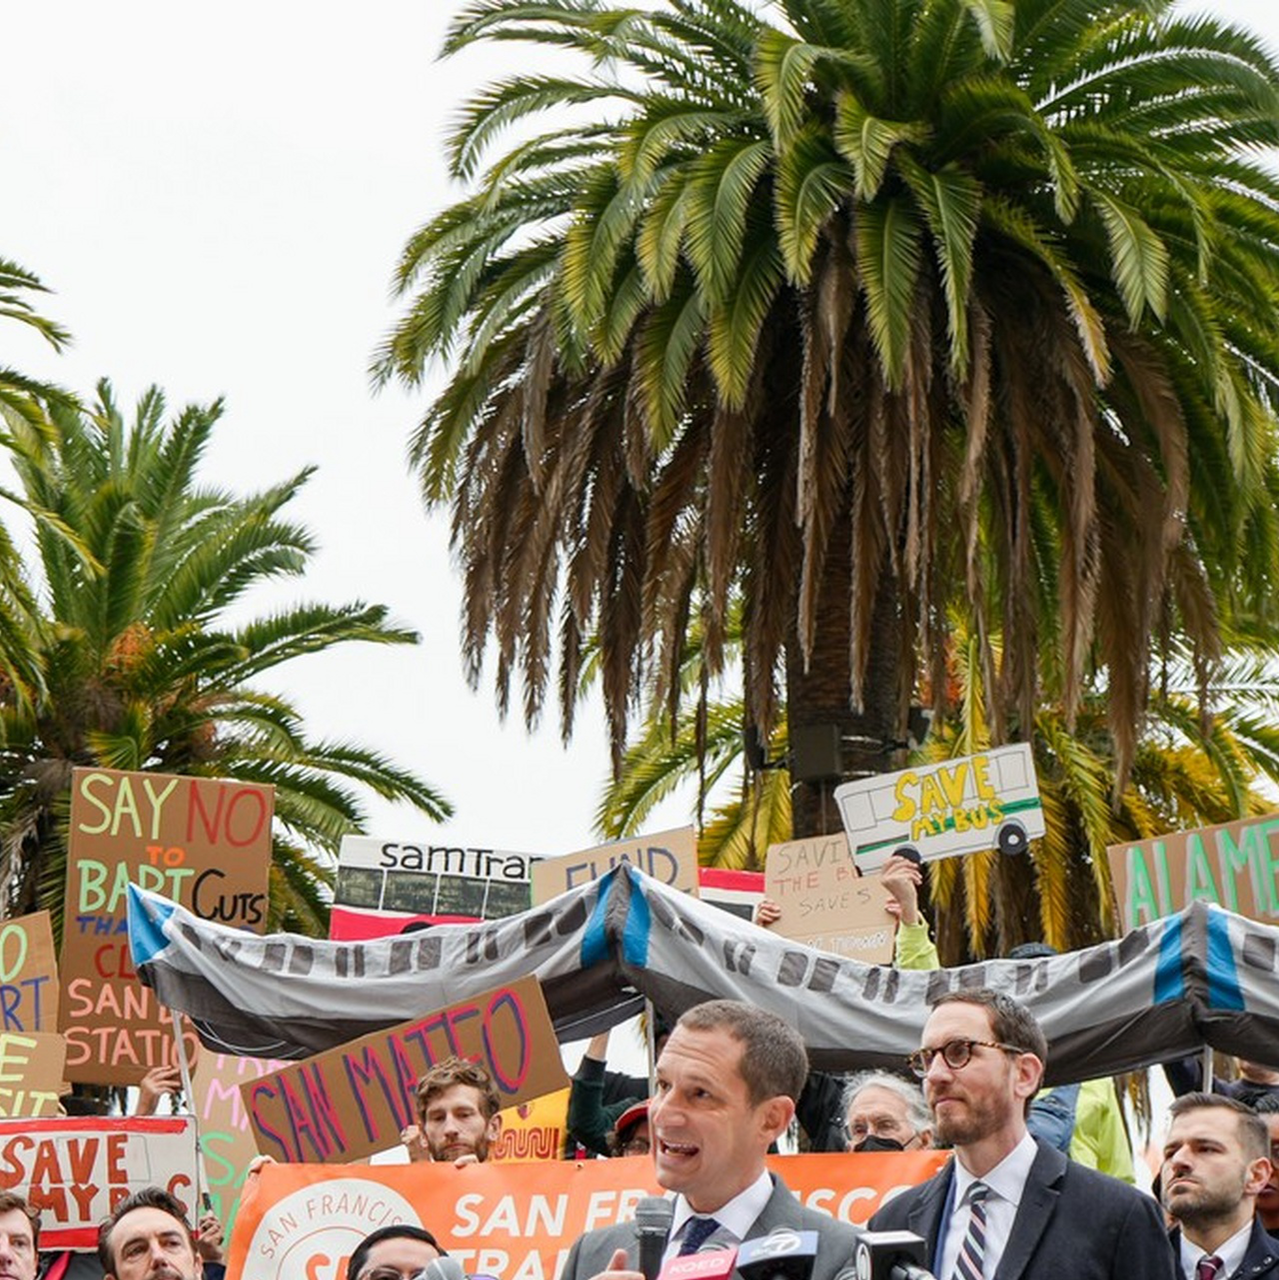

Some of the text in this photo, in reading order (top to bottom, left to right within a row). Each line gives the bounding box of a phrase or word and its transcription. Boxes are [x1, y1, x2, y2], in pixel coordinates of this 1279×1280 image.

[891, 756, 995, 822] SAVE
[78, 773, 267, 848] SAY NO
[911, 799, 1006, 841] MY BUS
[146, 846, 186, 867] TO
[379, 842, 545, 883] samTra
[778, 840, 854, 875] SAVI
[773, 873, 819, 897] THE
[799, 889, 872, 917] SAVES
[75, 916, 128, 936] THA
[69, 978, 148, 1021] SAN
[249, 1060, 348, 1164] SAN
[260, 1211, 299, 1260] SAN
[450, 1193, 569, 1239] SAN
[669, 1256, 727, 1274] KQED
